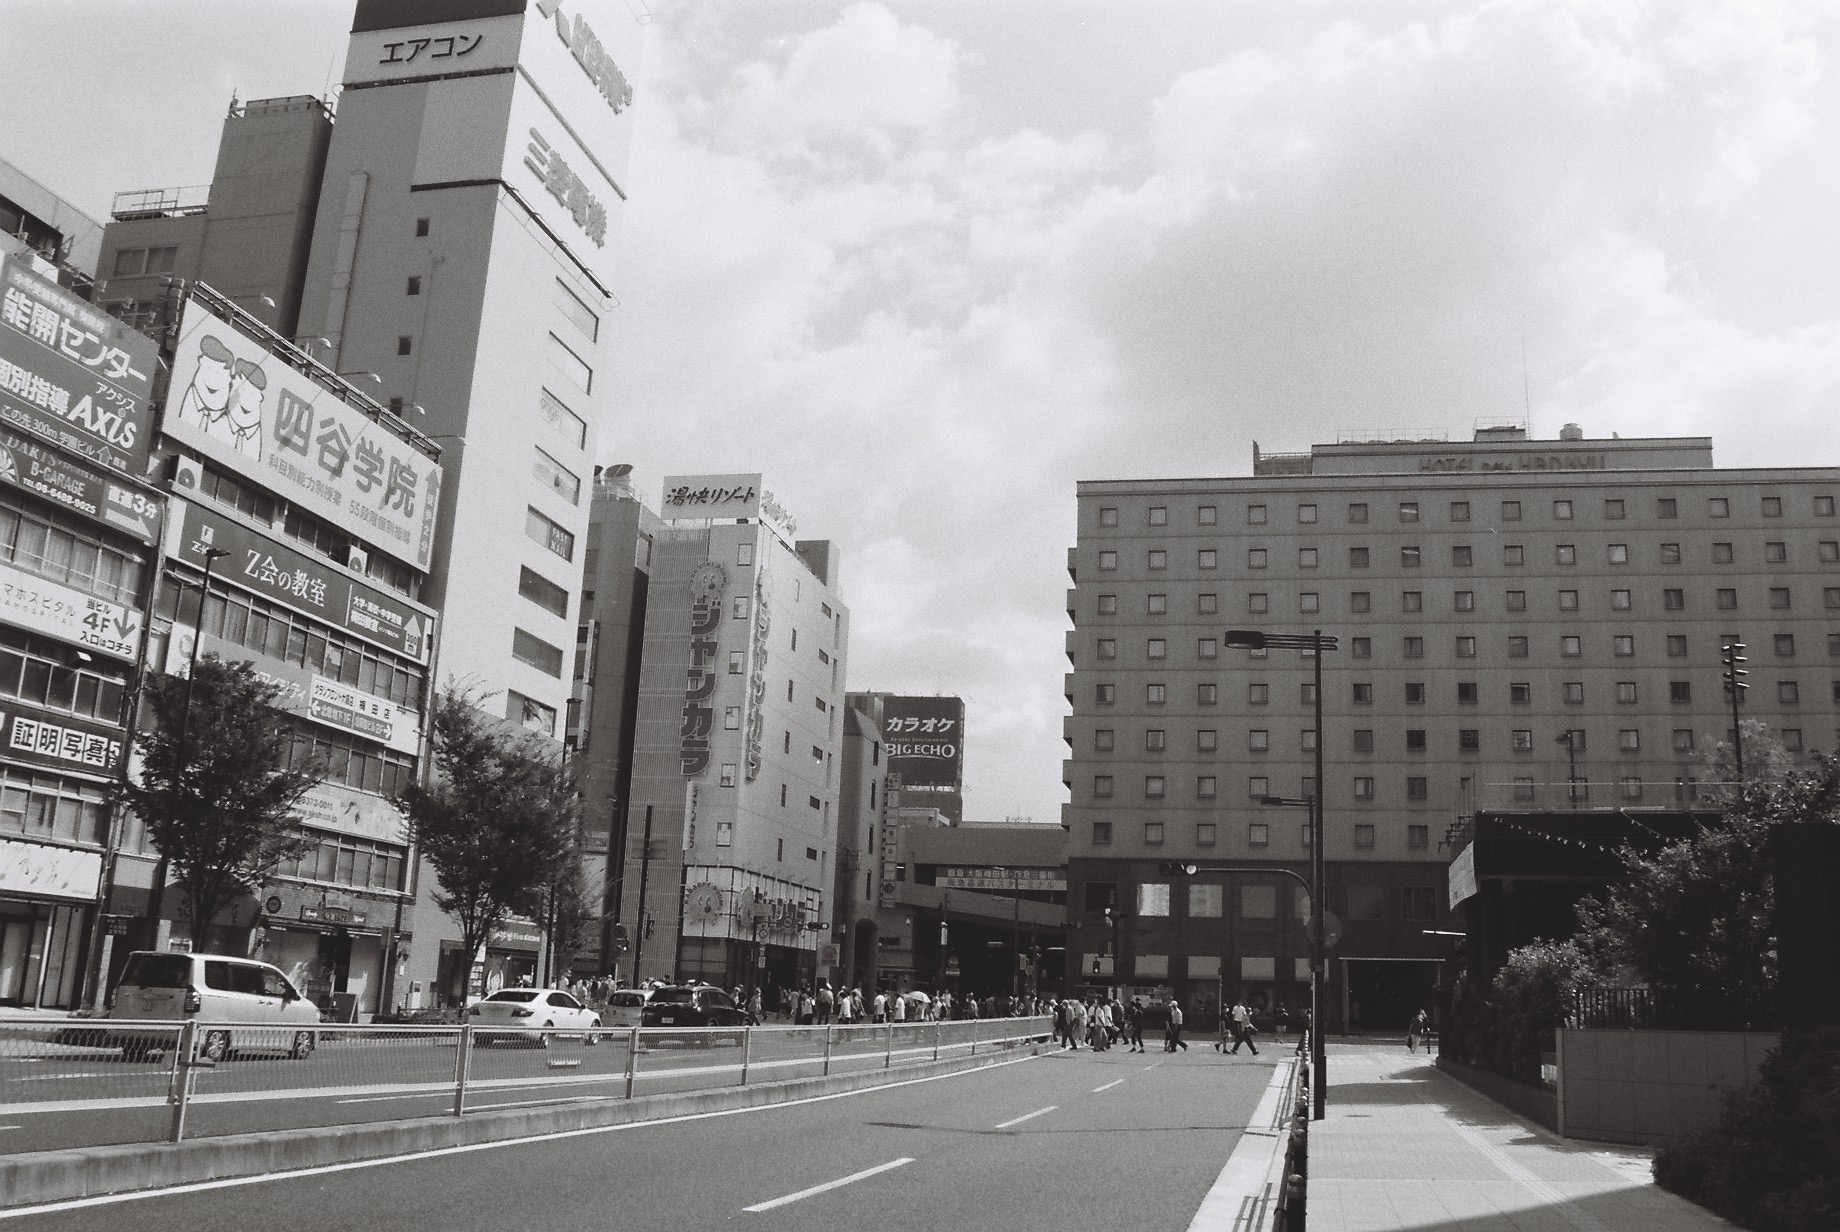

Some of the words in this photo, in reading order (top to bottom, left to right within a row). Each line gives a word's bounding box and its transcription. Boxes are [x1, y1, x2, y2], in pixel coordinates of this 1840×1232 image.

[379, 34, 483, 64] エアコン
[2, 286, 147, 382] 能開センター
[96, 381, 136, 413] アクシス
[274, 386, 420, 519] 四谷学院
[30, 460, 86, 498] B-GARAGE
[665, 486, 755, 507] 湯快リゾート
[244, 549, 327, 608] Z会の教室
[83, 612, 111, 633] 4F
[80, 630, 133, 656] 入口はコチラ
[680, 597, 721, 775] ジャンカラ
[886, 716, 956, 733] カラオケ
[14, 719, 106, 766] 証明写真
[883, 743, 912, 757] BIG
[914, 743, 956, 759] ECHO
